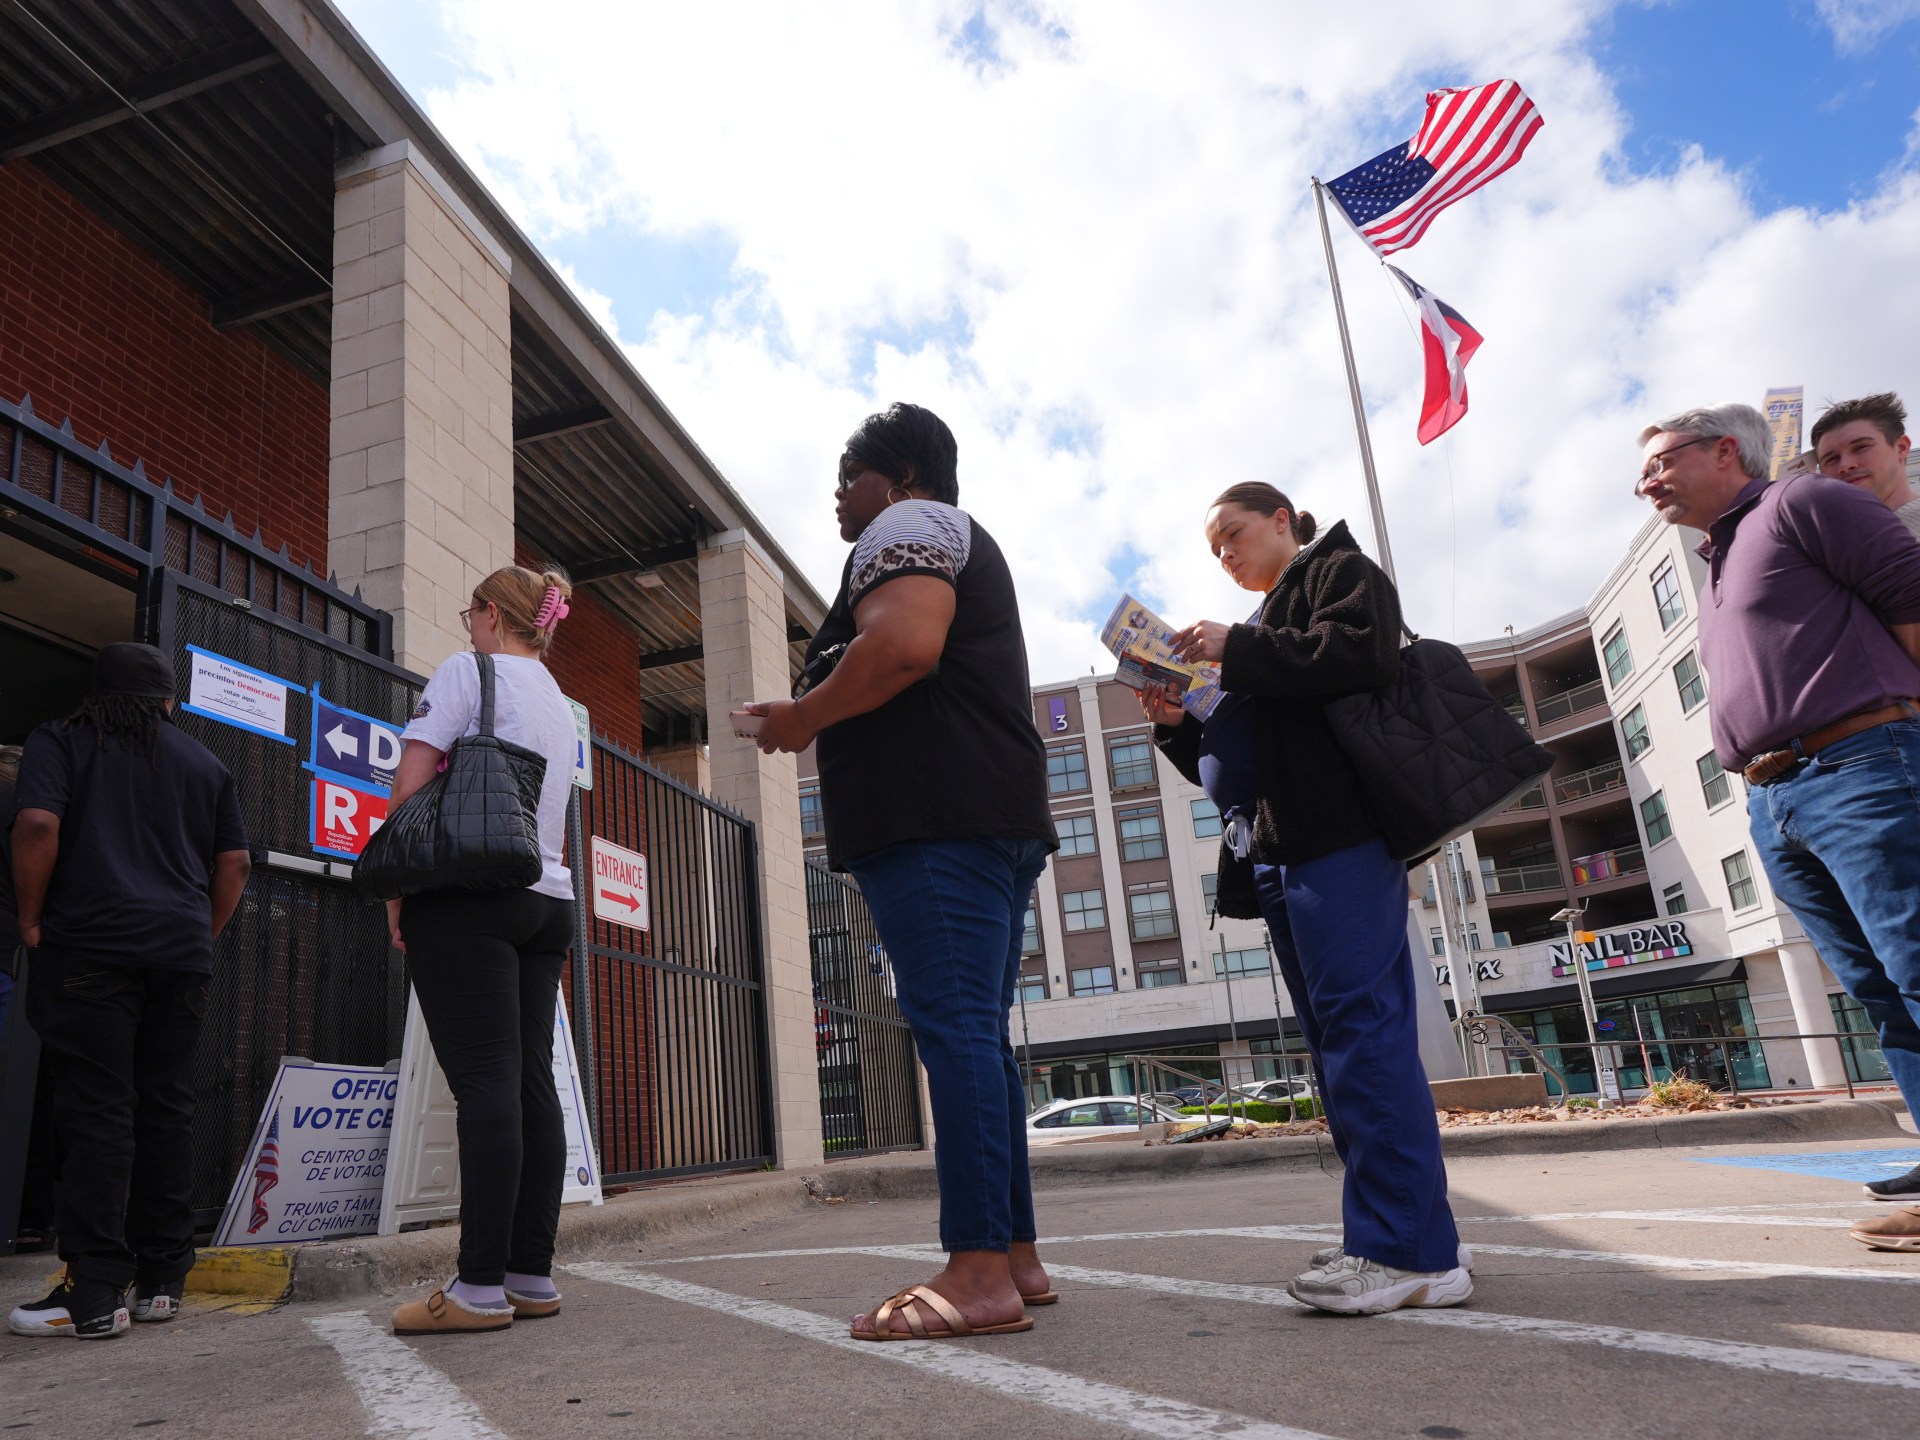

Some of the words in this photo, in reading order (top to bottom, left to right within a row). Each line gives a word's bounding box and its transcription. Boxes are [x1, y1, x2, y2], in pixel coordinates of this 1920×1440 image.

[198, 668, 235, 686] precintos
[220, 663, 231, 673] Los
[232, 669, 263, 684] siguientes
[223, 688, 240, 698] votan
[1055, 714, 1068, 731] 3
[368, 722, 402, 771] D
[324, 782, 359, 836] R
[595, 850, 644, 890] ENTRANCE
[1547, 934, 1624, 967] NAIL
[1628, 921, 1687, 953] BAR
[331, 1077, 398, 1101] OFFIC
[292, 1106, 365, 1130] VOTE
[366, 1107, 394, 1129] CE
[301, 1148, 365, 1164] CENTRO
[368, 1147, 389, 1161] OF
[305, 1167, 331, 1181] DE
[283, 1199, 339, 1217] TRUNG
[343, 1194, 375, 1212] TÂM
[307, 1213, 358, 1232] CHÍNH
[360, 1213, 380, 1226] TH
[155, 1301, 166, 1309] 23
[118, 1313, 128, 1322] 23
